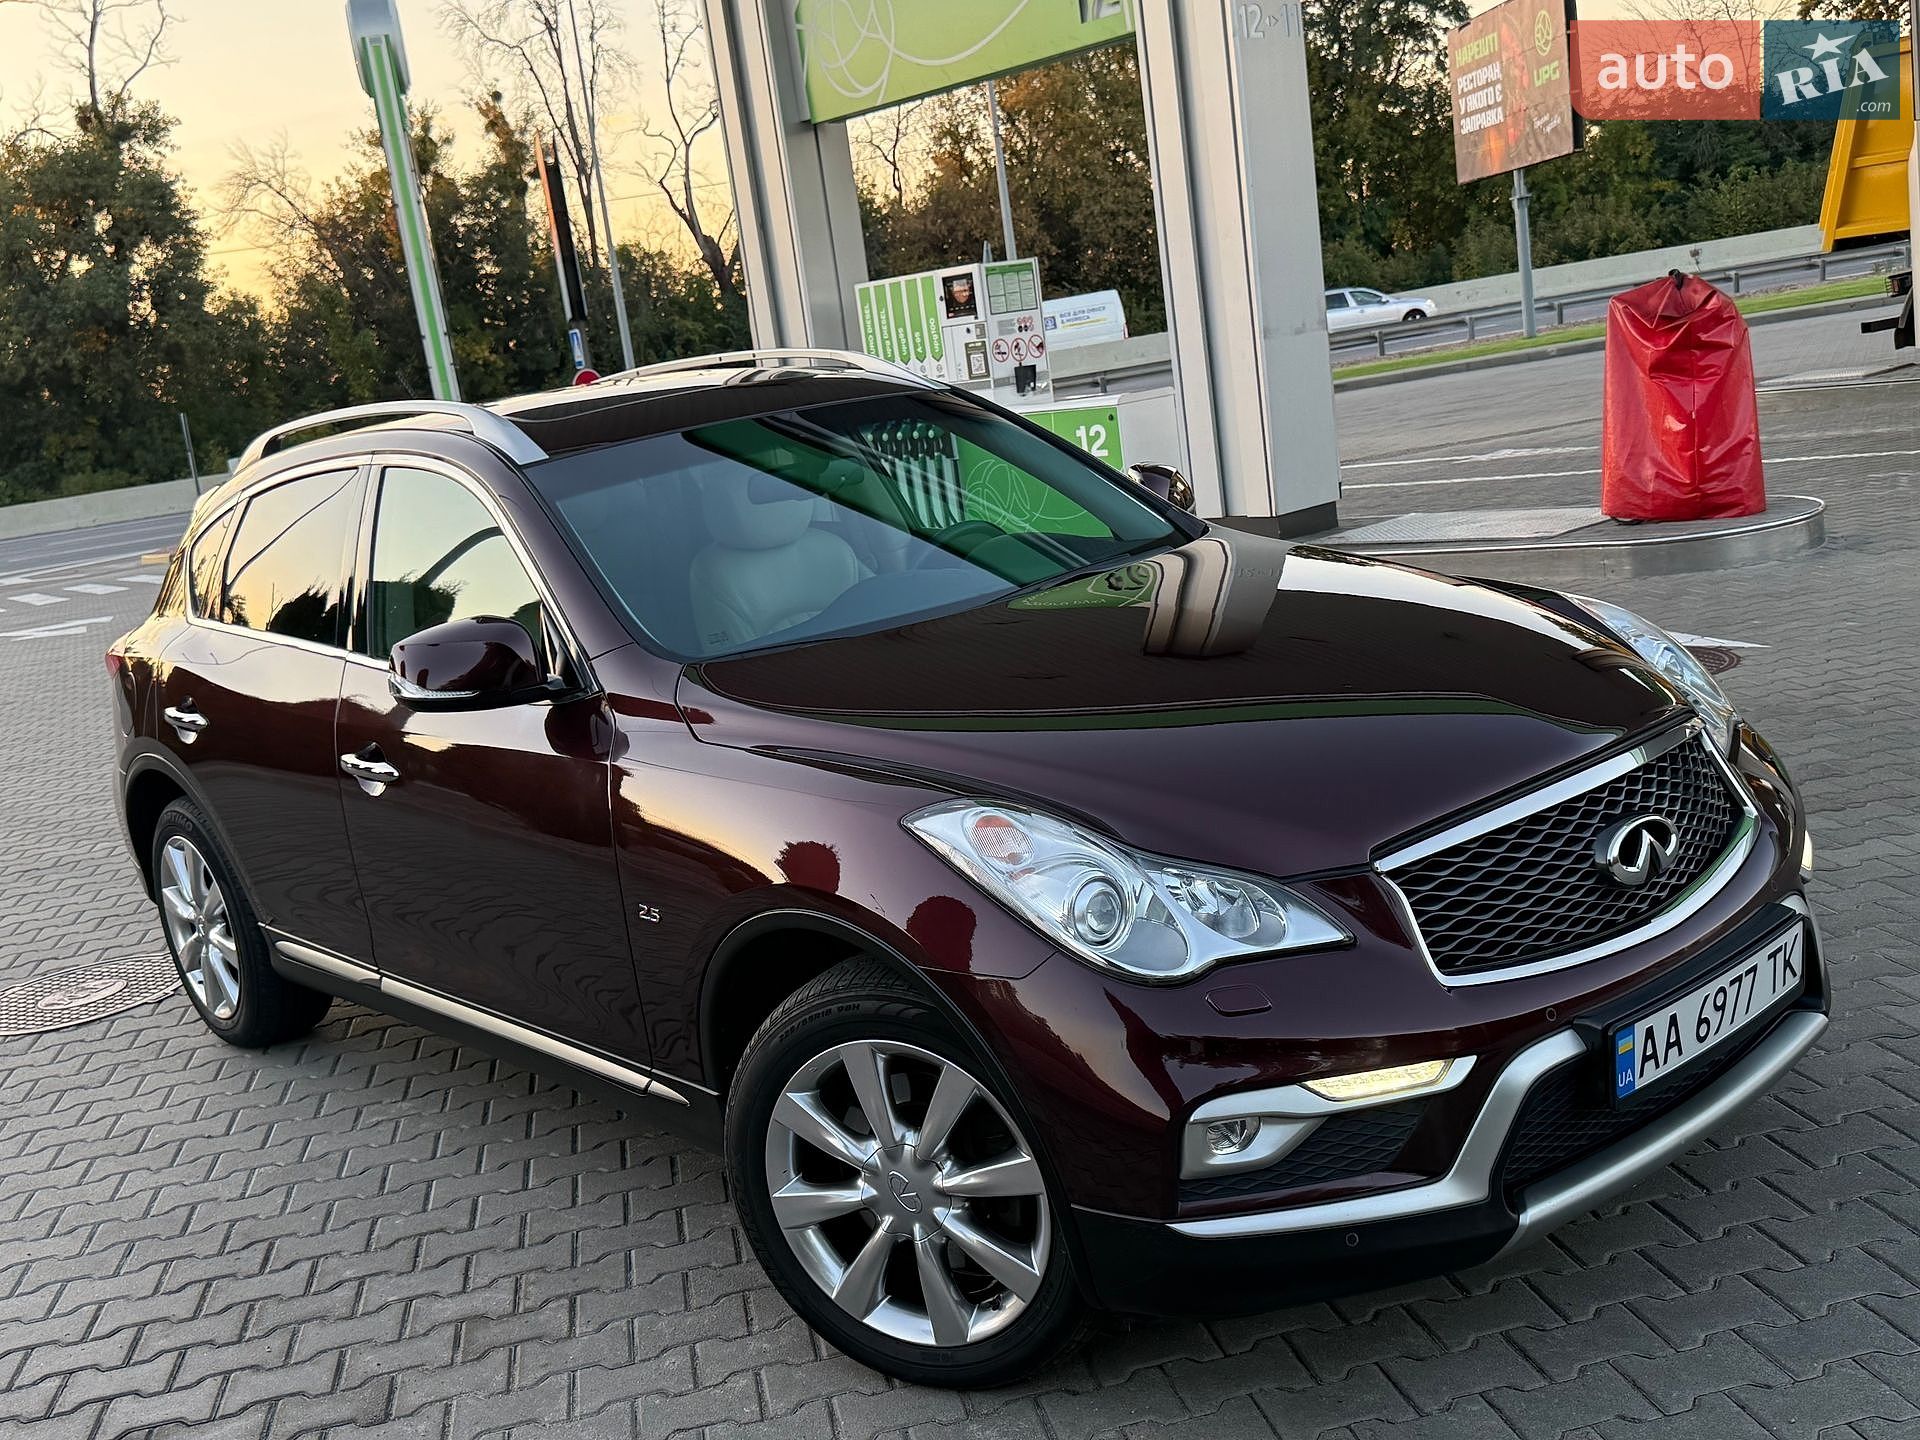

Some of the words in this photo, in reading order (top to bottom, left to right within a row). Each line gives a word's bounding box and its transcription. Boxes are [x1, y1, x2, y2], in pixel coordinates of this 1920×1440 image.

[1533, 60, 1560, 87] UPG
[1459, 97, 1466, 115] У
[1467, 86, 1494, 113] ЯКОГО
[1460, 106, 1505, 135] ЗАПРАВКА
[1075, 424, 1109, 457] 12
[1638, 1011, 1684, 1080] AA
[1695, 962, 1758, 1044] 6977
[1767, 932, 1799, 995] TK
[1618, 1068, 1634, 1087] UA
